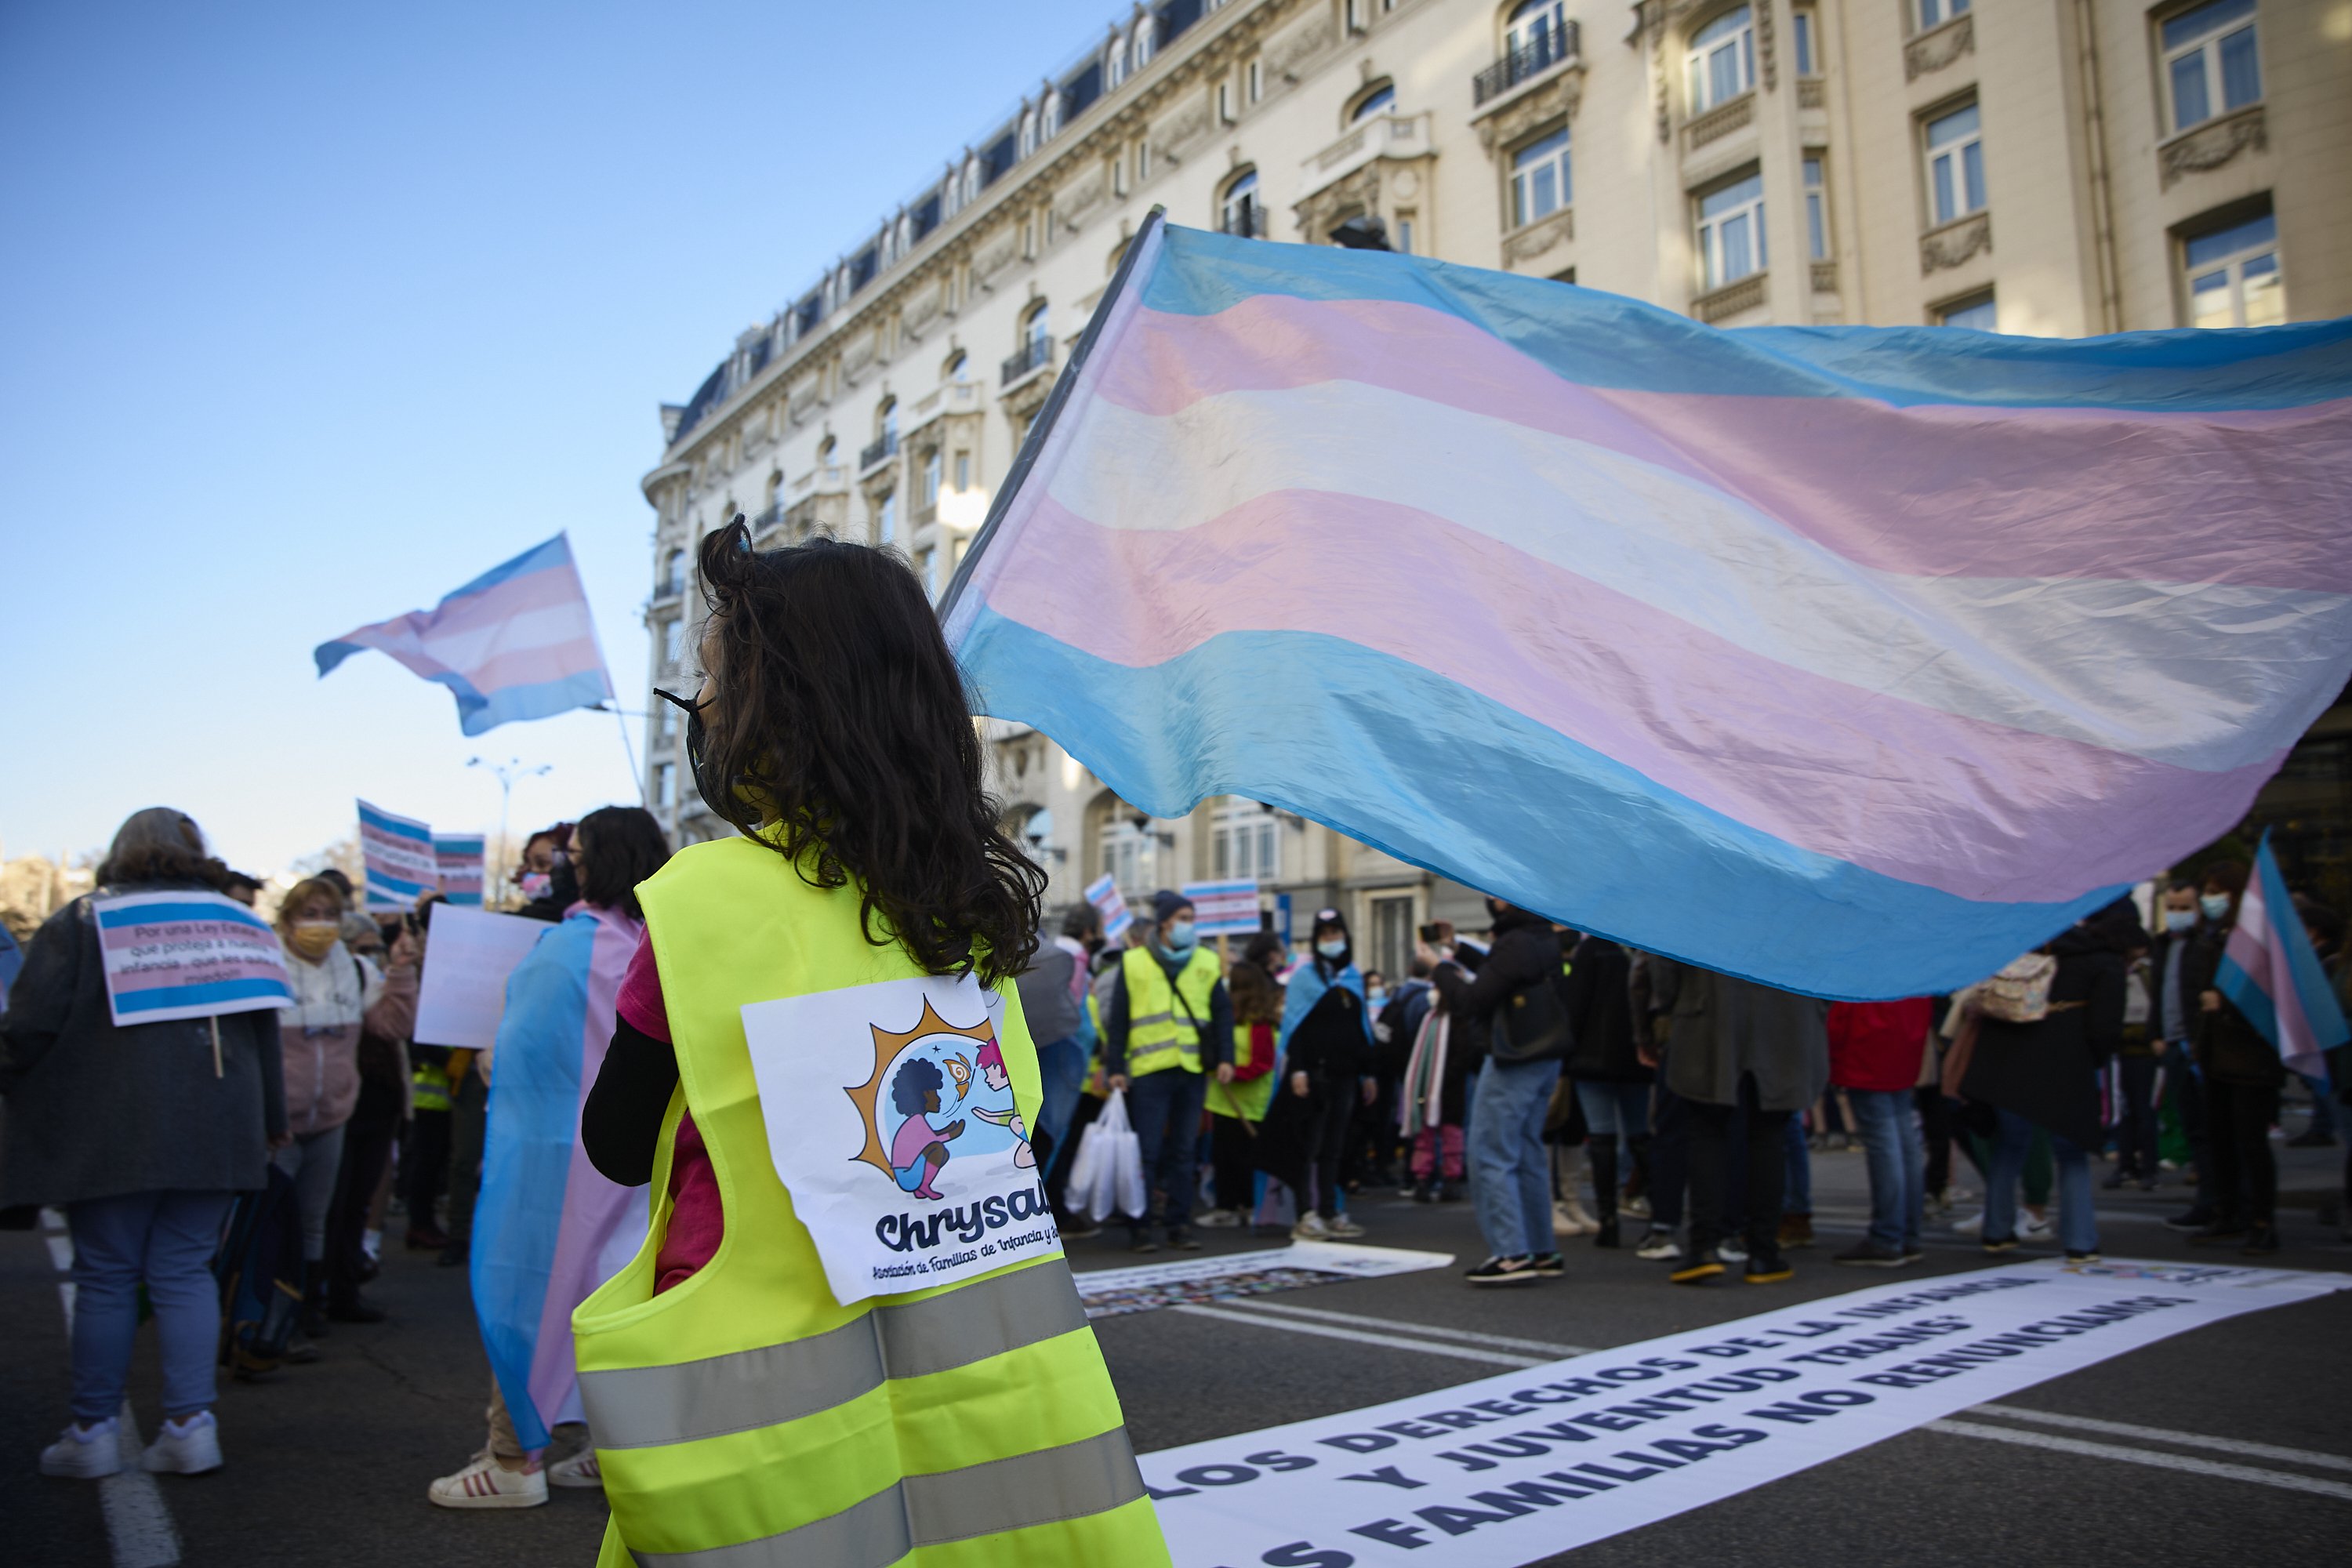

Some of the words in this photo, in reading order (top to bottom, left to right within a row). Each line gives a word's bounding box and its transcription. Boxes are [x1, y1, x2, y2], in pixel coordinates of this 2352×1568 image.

[131, 943, 158, 957] que
[134, 926, 161, 938] Por
[164, 924, 192, 936] una
[873, 1261, 916, 1280] Asociación
[916, 1261, 929, 1275] de
[929, 1250, 977, 1272] Familias
[981, 1243, 996, 1258] de
[997, 1231, 1044, 1253] Infancia
[1044, 1229, 1052, 1245] y
[1314, 1357, 1700, 1454] DERECHOS
[1684, 1337, 1787, 1358] DE
[1762, 1320, 1861, 1338] LA
[1834, 1276, 2051, 1319] INFANCIA
[1334, 1465, 1430, 1490] Y
[1432, 1367, 1802, 1472] JUVENTUD
[1345, 1424, 1769, 1549] FAMILIAS
[1744, 1389, 1876, 1424] NO
[1850, 1294, 2198, 1388] RENUNCIAMOS
